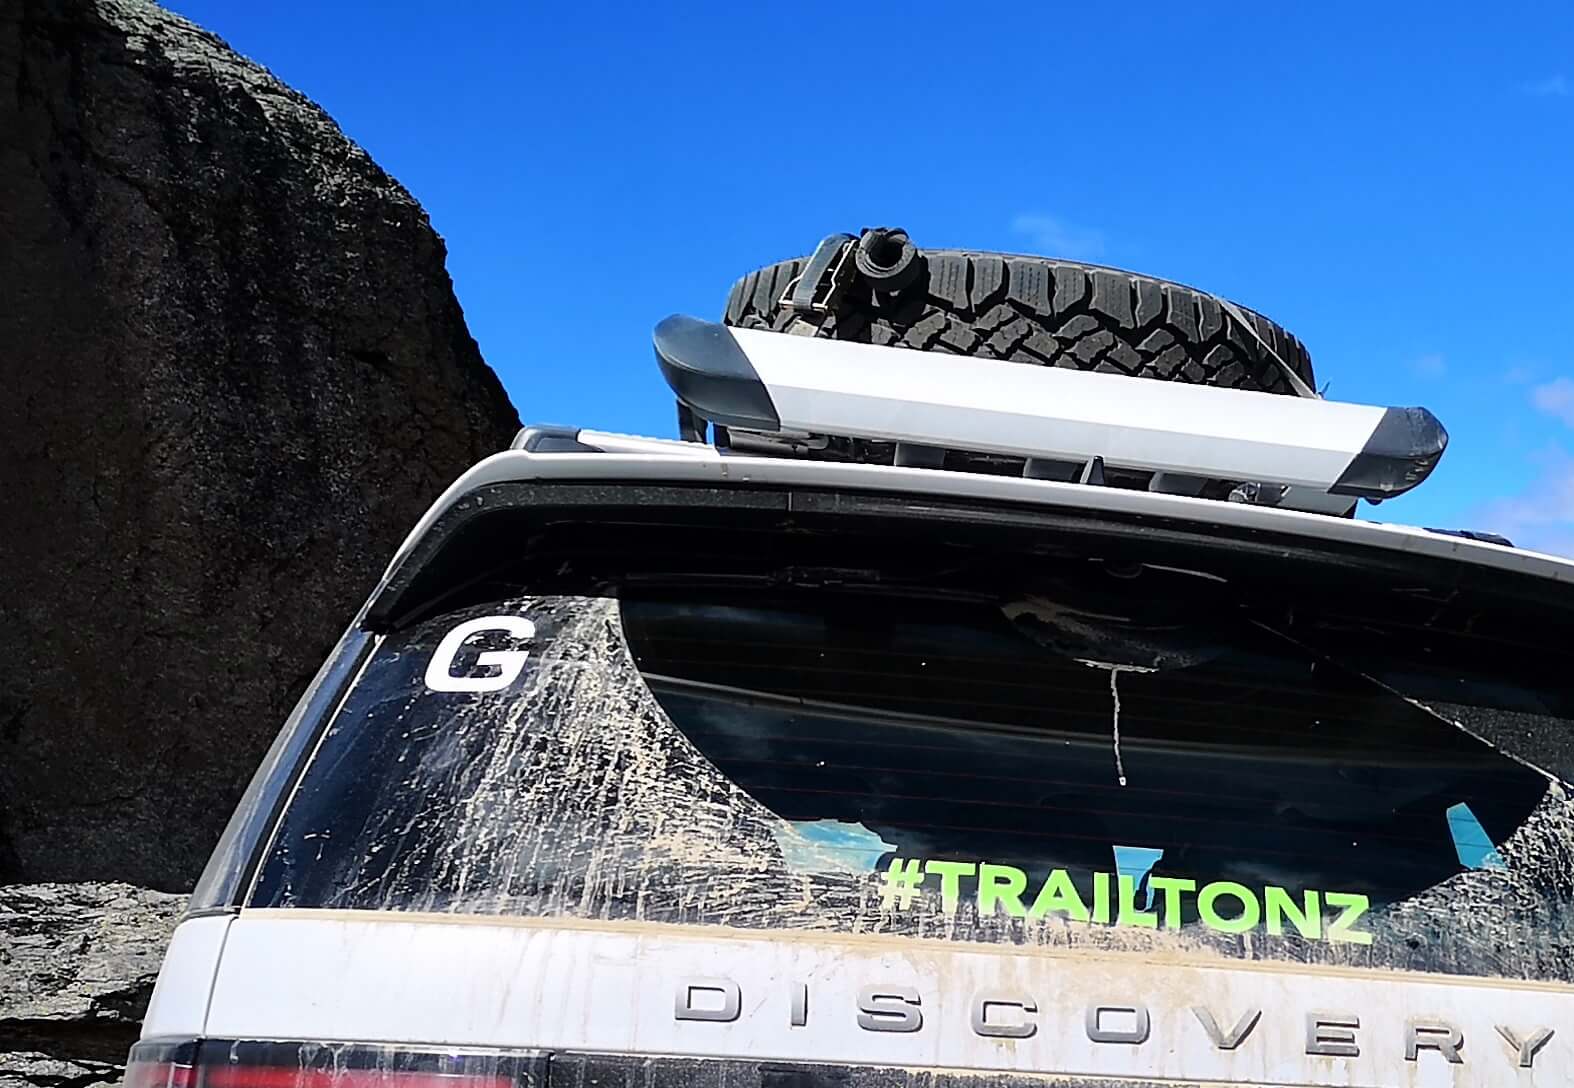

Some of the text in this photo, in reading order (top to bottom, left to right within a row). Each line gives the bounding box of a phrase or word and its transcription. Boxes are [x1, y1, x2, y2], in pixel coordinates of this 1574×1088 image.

[424, 614, 536, 694] G
[878, 857, 1374, 945] #TRAILTONZ
[674, 974, 1556, 1068] DISCOVERY
